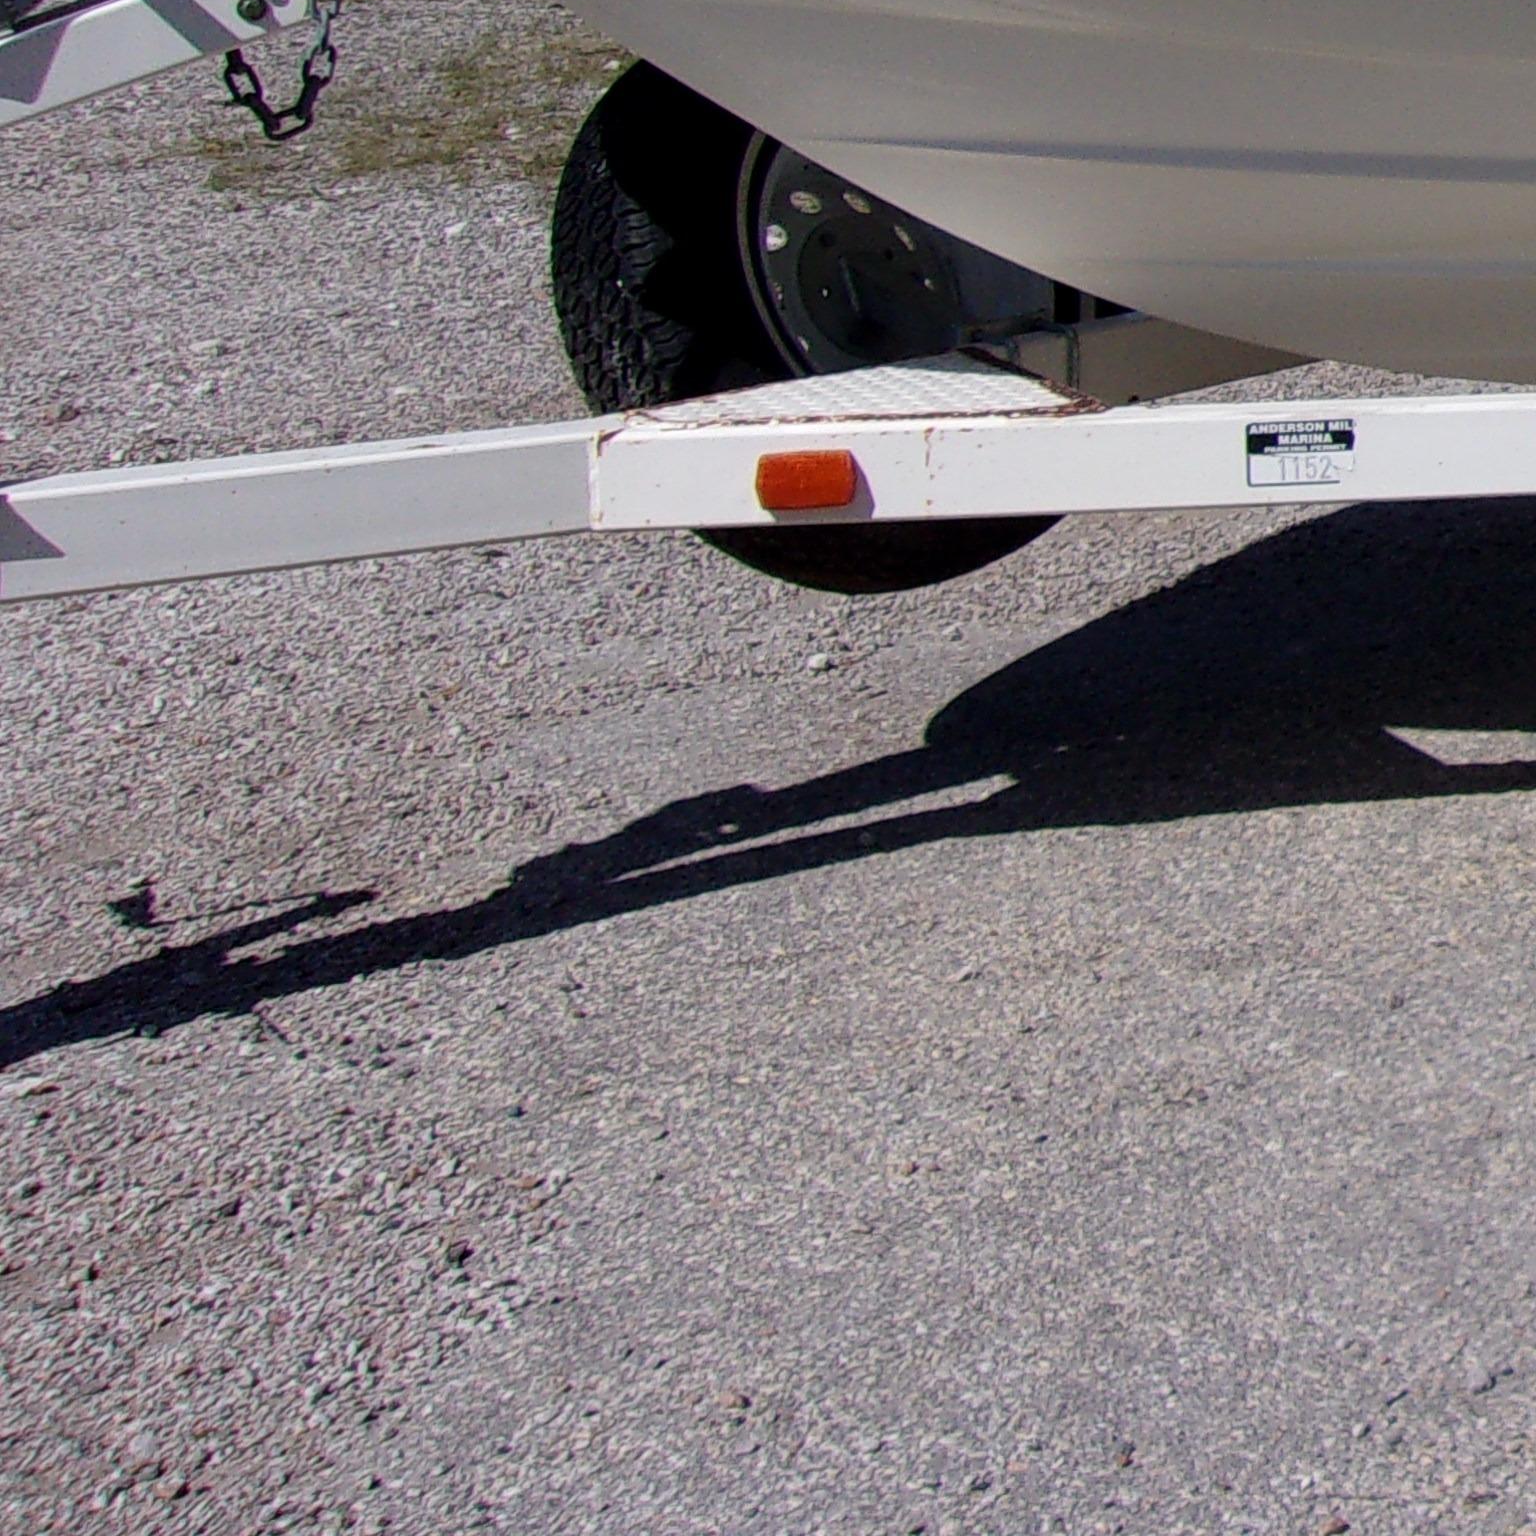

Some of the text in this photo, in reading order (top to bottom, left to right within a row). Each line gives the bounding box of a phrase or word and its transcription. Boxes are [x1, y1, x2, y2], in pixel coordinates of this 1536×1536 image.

[1249, 420, 1355, 435] ANDERSON MIL
[1278, 432, 1333, 445] MARINA
[1278, 454, 1333, 481] 1152
